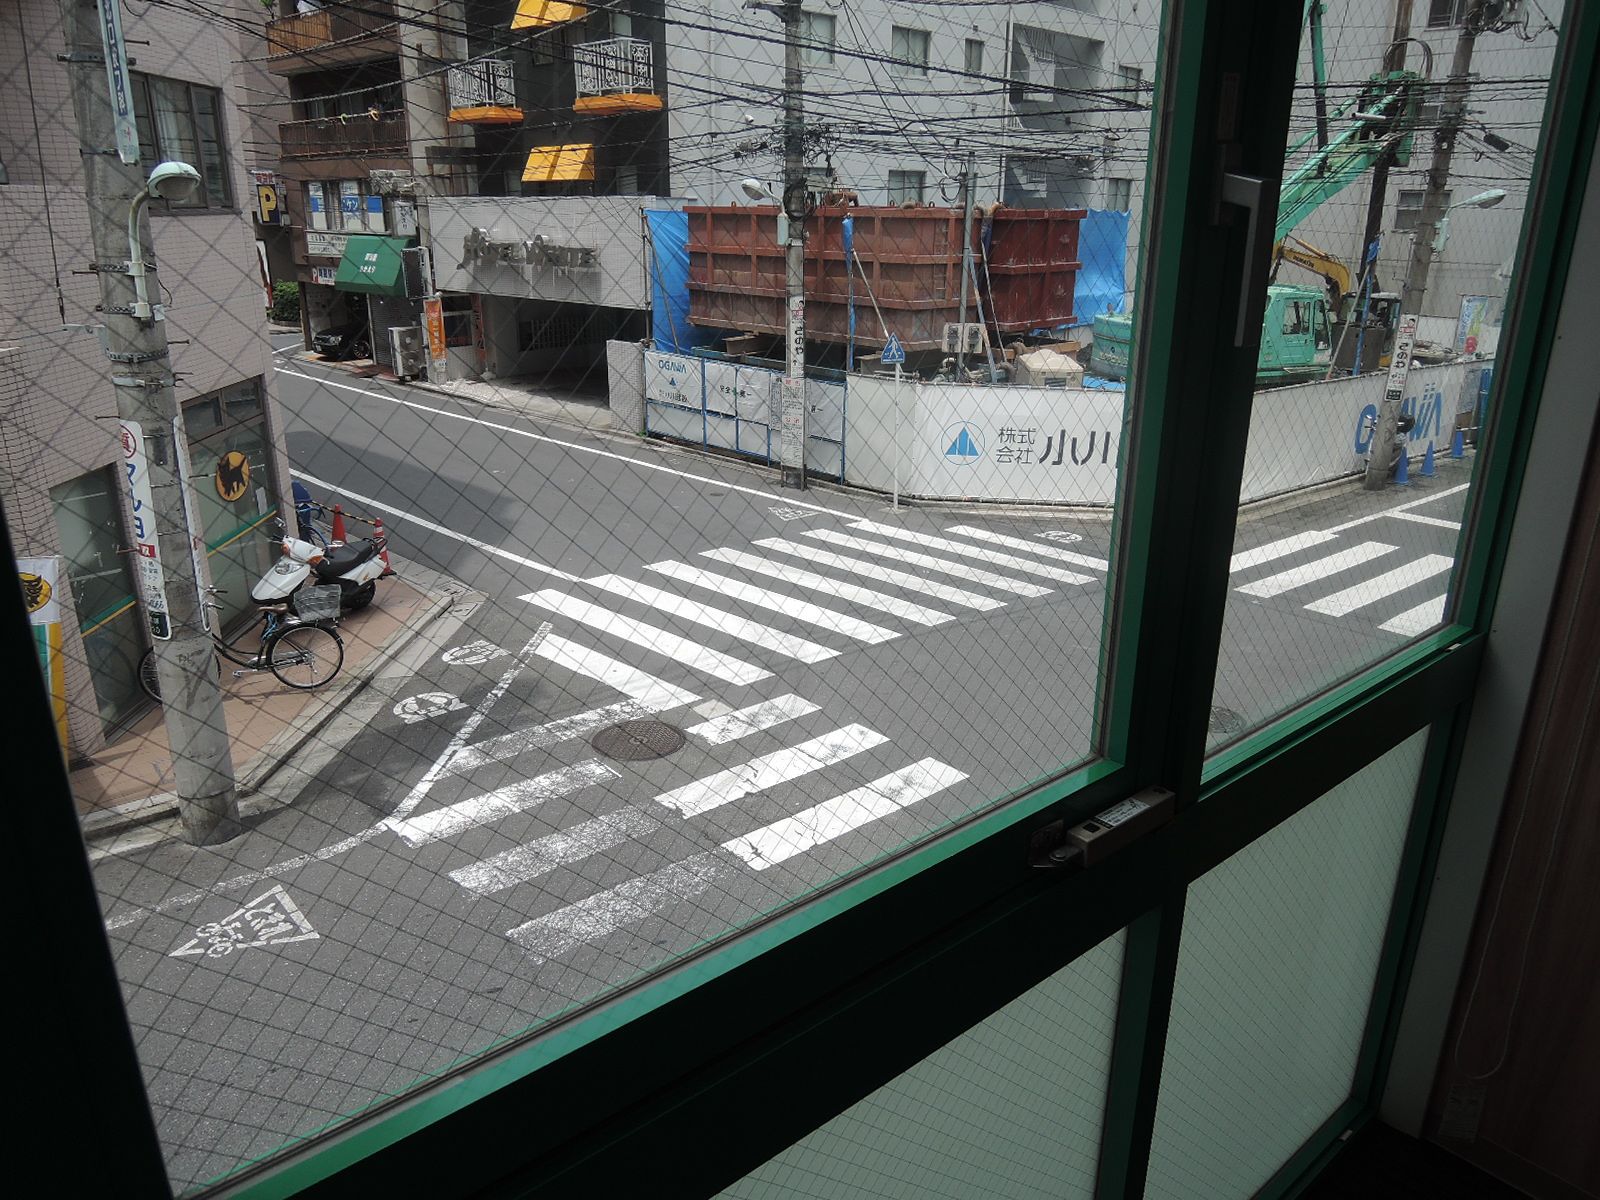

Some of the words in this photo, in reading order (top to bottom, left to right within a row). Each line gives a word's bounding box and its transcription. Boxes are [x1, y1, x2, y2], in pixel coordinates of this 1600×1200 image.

[258, 186, 277, 221] P
[658, 359, 687, 373] OGAWA
[1355, 383, 1442, 454] OWA
[998, 427, 1036, 445] 株式
[996, 445, 1033, 464] 会社
